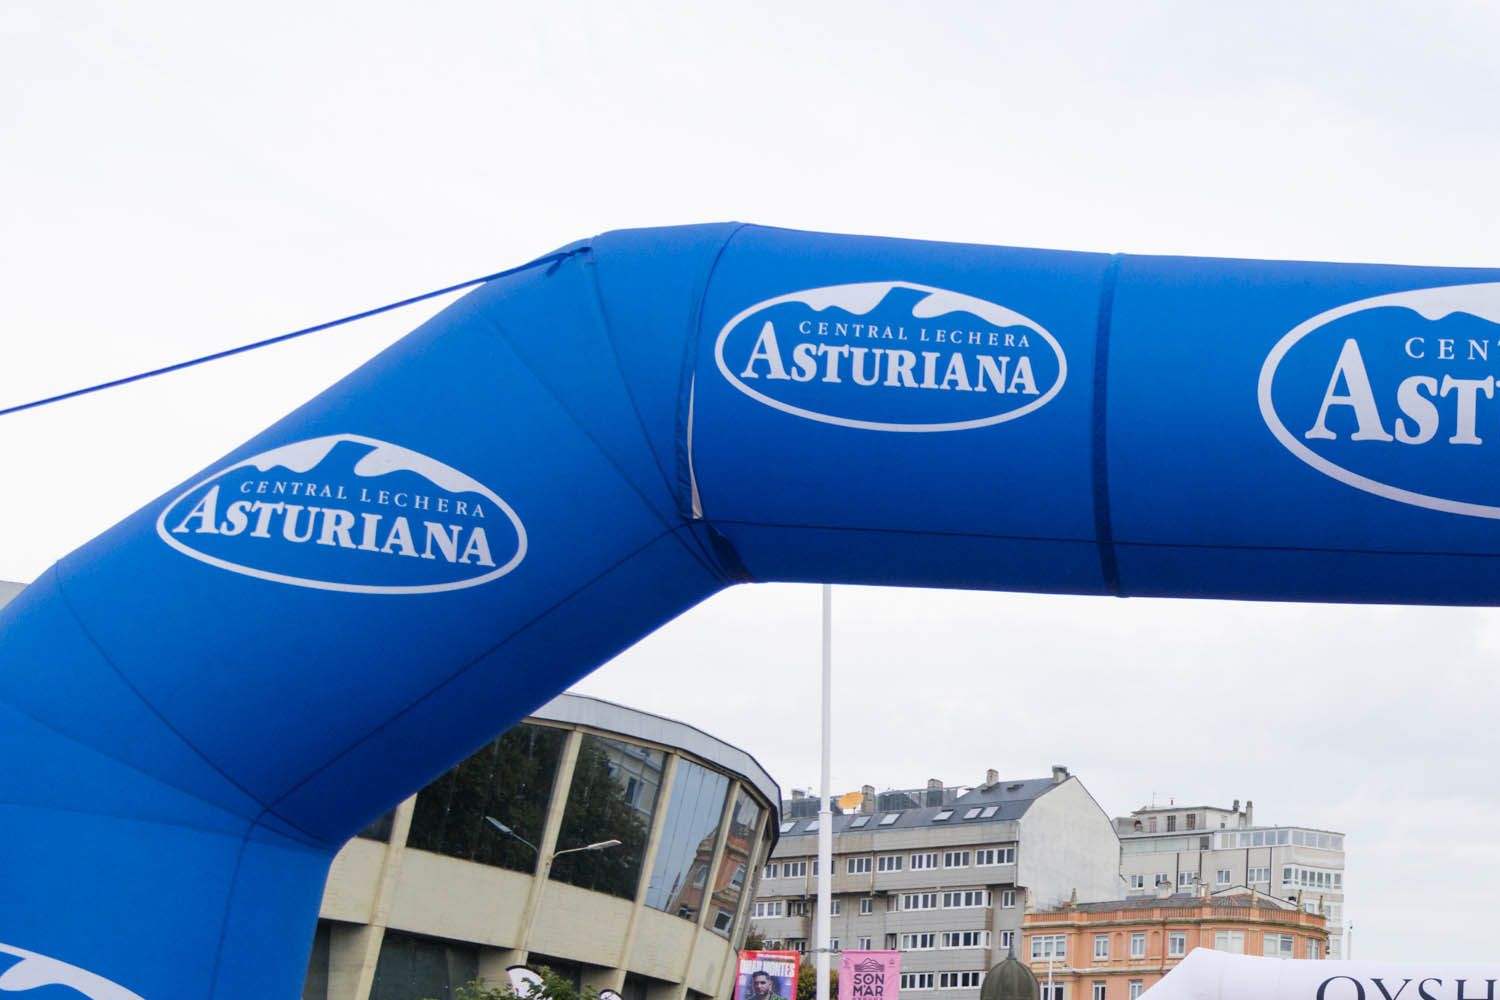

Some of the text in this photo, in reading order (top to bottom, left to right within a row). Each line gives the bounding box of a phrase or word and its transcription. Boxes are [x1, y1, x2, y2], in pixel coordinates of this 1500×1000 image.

[798, 320, 1030, 347] CENTRAL LECHERA
[740, 321, 1040, 395] ASTURIANA
[240, 480, 486, 517] CENTRAL LECHERA
[173, 485, 495, 567] ASTURIANA
[854, 973, 885, 985] SON
